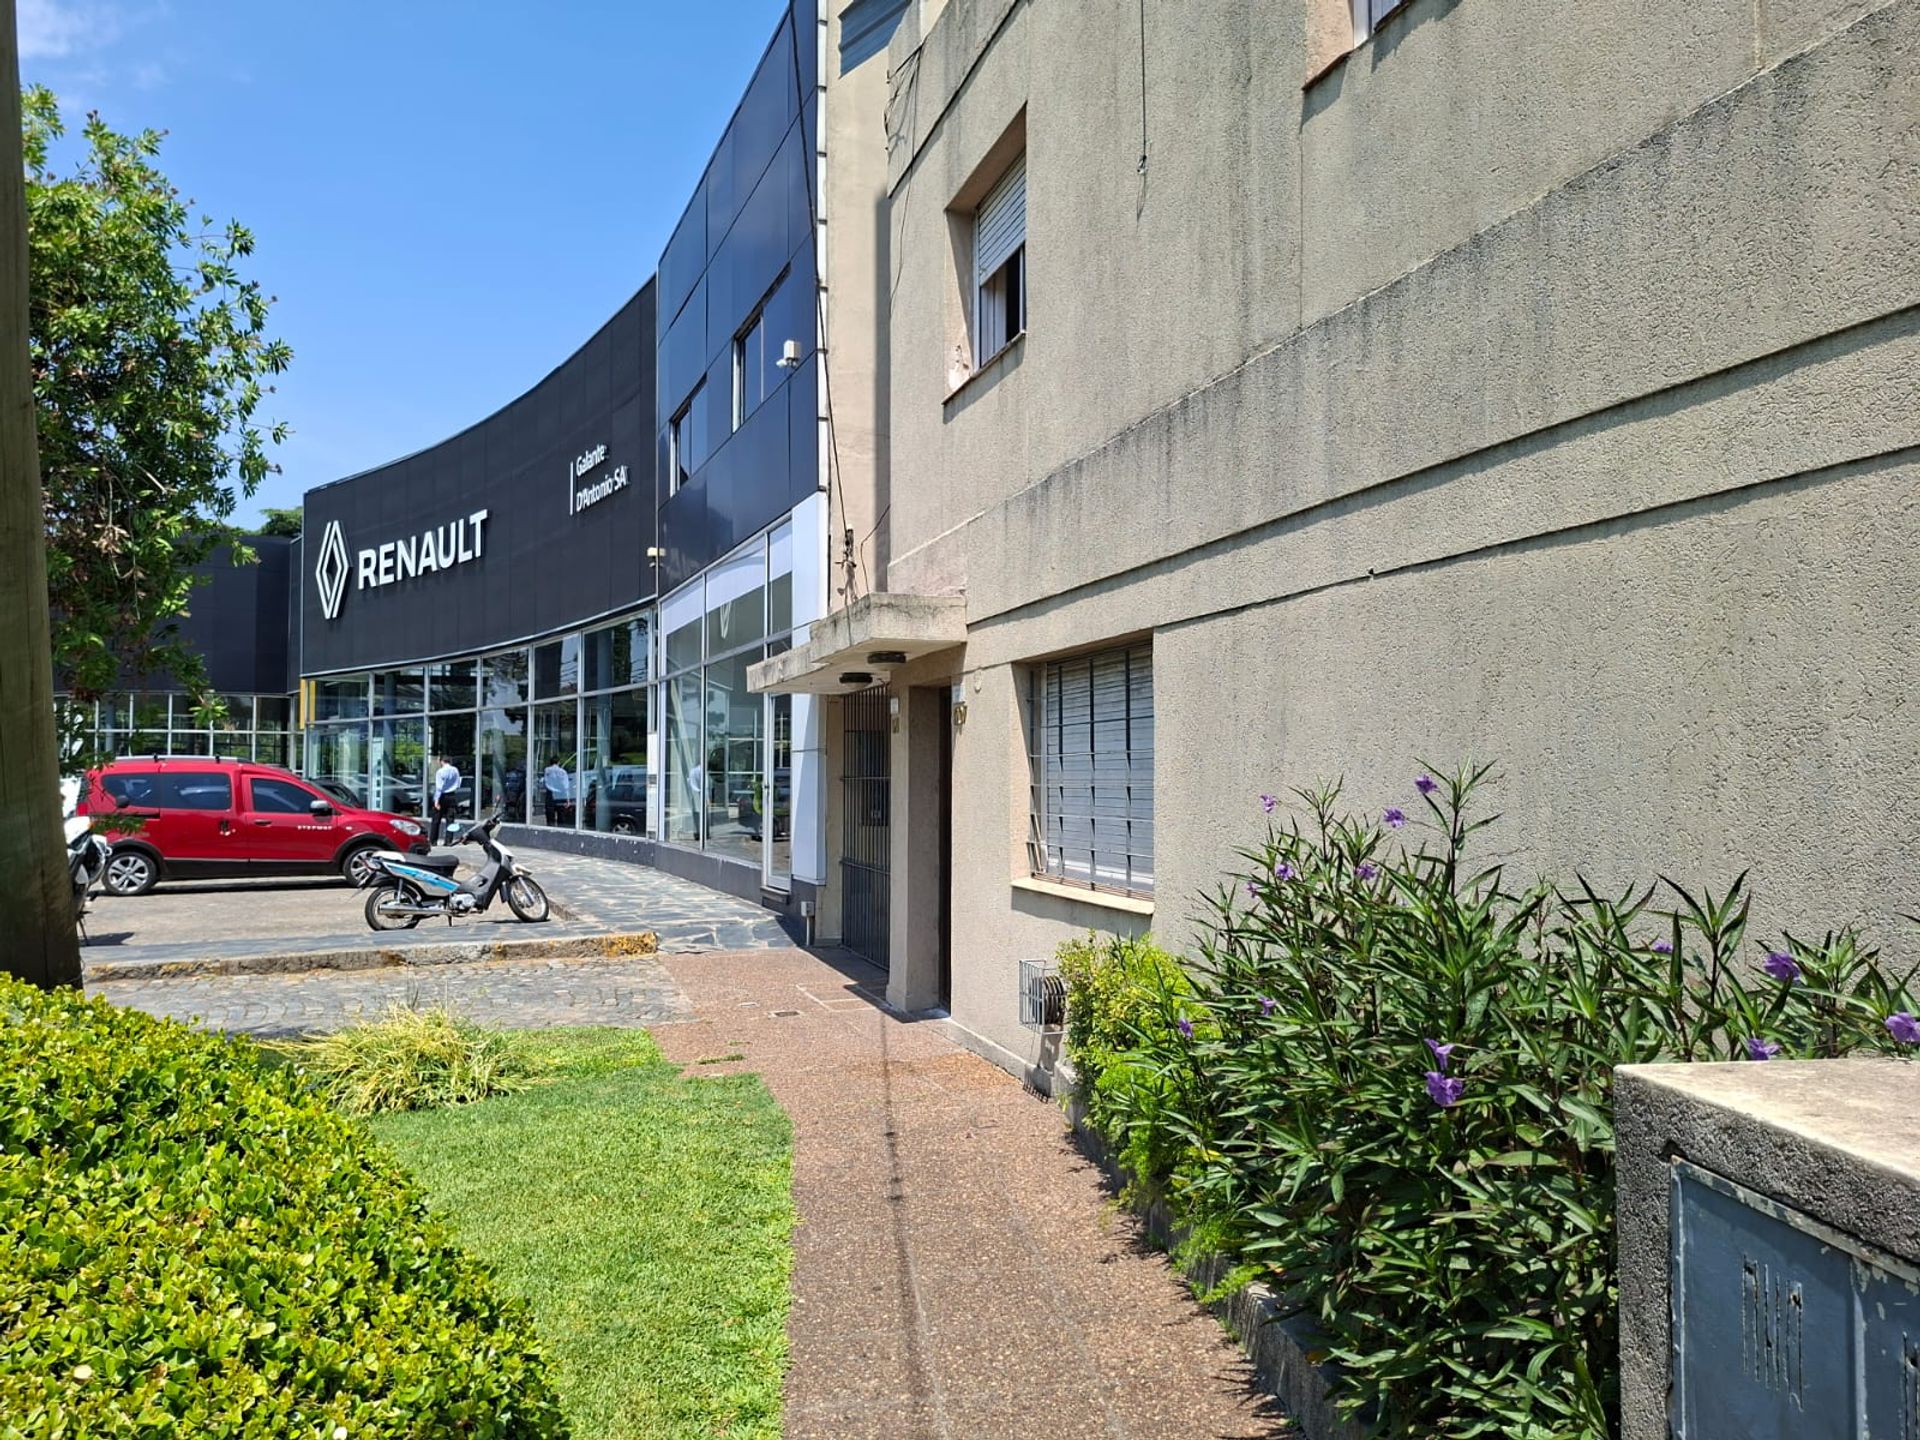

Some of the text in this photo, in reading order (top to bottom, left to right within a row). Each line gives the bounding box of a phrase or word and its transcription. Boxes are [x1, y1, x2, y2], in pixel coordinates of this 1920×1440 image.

[576, 444, 606, 476] Galante
[614, 465, 628, 491] SA
[358, 509, 488, 590] RENAULT
